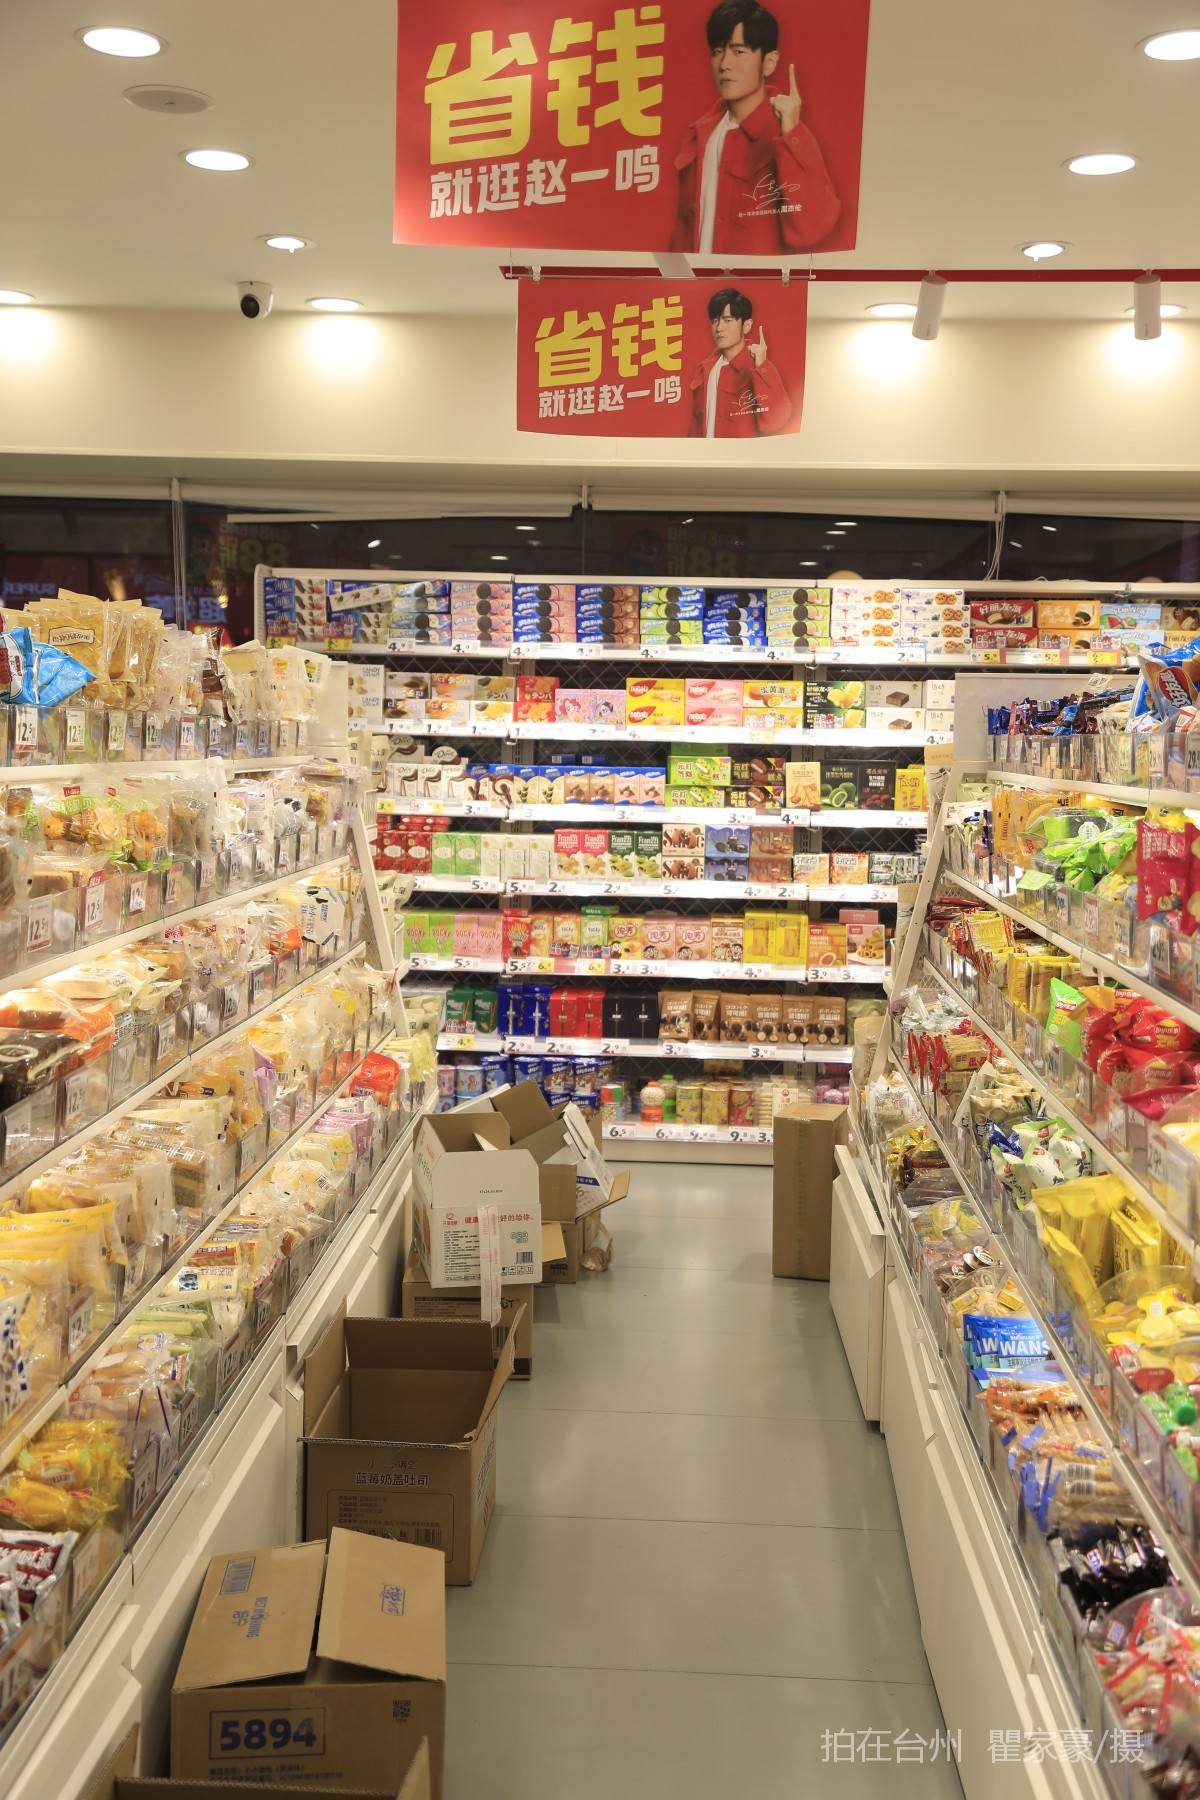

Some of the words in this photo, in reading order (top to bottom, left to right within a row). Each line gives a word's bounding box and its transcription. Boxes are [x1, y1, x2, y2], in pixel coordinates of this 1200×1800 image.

[424, 4, 666, 165] 省钱
[429, 144, 661, 219] 就逛赵一鸣
[535, 295, 684, 387] 省钱
[538, 375, 682, 418] 就逛赵一鸣
[387, 641, 406, 652] 4.9
[452, 643, 471, 654] 4.9
[766, 649, 788, 661] 4.9
[17, 722, 33, 742] 12.5
[926, 734, 945, 745] 4.9
[781, 814, 799, 825] 4.9
[603, 883, 621, 894] 2.9
[87, 901, 101, 924] 12.5
[29, 917, 47, 942] 12.5
[810, 969, 828, 981] 3.9
[507, 1041, 525, 1052] 2.9
[546, 1042, 565, 1053] 2.9
[601, 1043, 620, 1054] 2.9
[664, 1044, 682, 1055] 3.9
[751, 1047, 768, 1058] 3.9
[609, 1126, 627, 1137] 6.5
[356, 1471, 429, 1488] 蓝莓奶盖吐司
[220, 1717, 316, 1750] 5894
